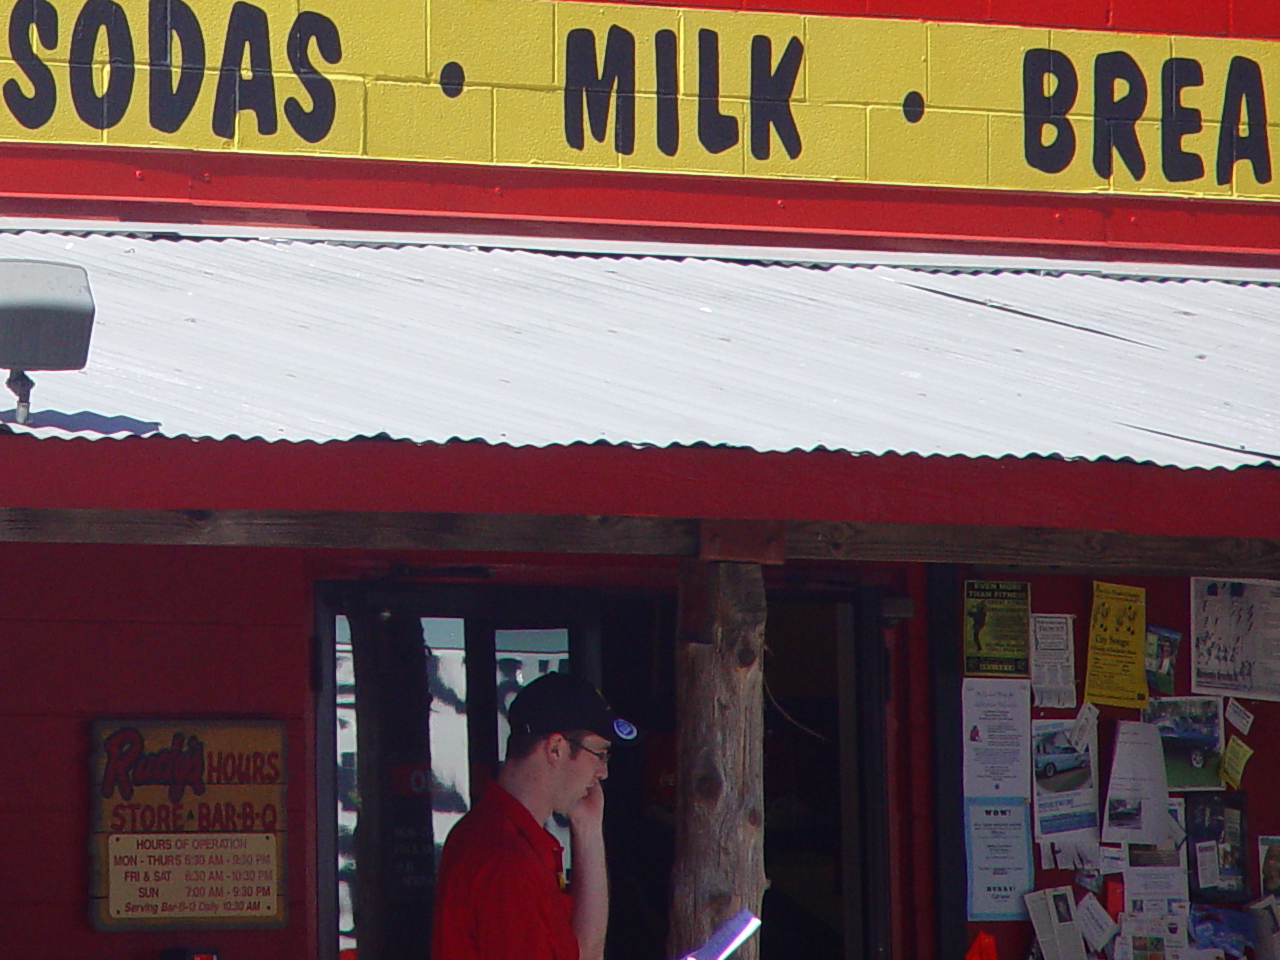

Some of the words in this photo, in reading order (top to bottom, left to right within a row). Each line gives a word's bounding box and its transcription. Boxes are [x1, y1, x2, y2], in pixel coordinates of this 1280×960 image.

[564, 23, 805, 160] MILK
[1022, 47, 1273, 186] BREA
[101, 727, 206, 803] Rudy's
[207, 751, 280, 784] HOURS
[110, 803, 185, 832] STORE
[197, 802, 278, 832] BAR-B-Q
[136, 839, 172, 850] HOURS
[175, 840, 189, 850] OF
[191, 839, 247, 850] OPERATION
[113, 855, 138, 866] MON
[148, 855, 182, 866] THURS
[208, 855, 224, 865] AM
[124, 871, 140, 882] FRI
[153, 871, 172, 882] SAT
[208, 871, 224, 882] AM
[138, 887, 160, 898] SUN
[208, 887, 224, 897] AM
[256, 886, 271, 897] PM
[124, 902, 159, 914] Serving
[246, 901, 261, 911] AM
